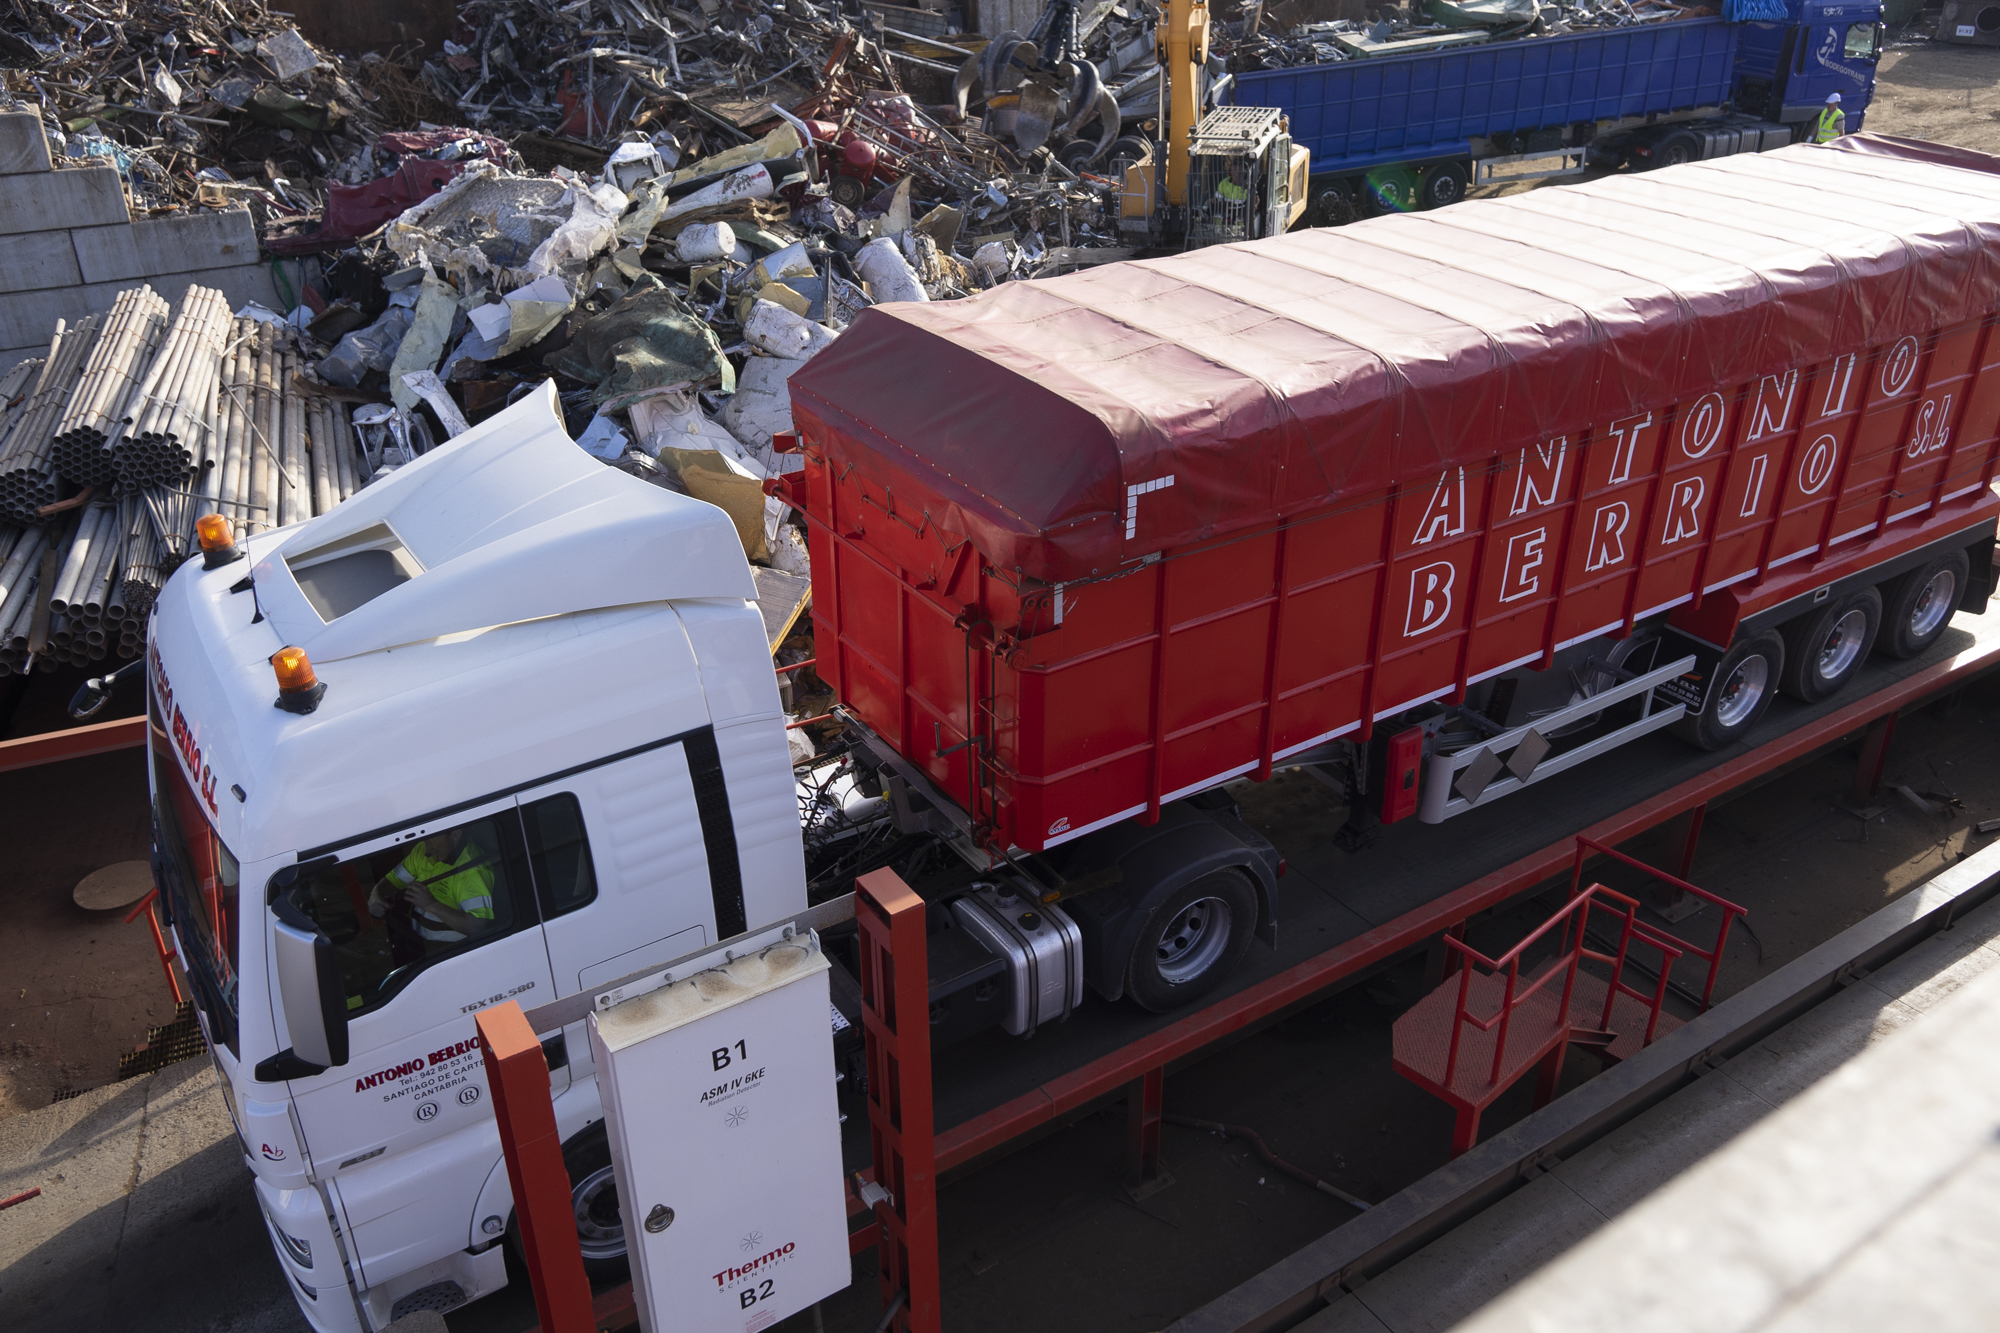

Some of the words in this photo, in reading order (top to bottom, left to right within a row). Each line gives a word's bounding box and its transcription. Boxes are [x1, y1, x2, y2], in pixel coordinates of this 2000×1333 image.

[1825, 60, 1865, 82] BODEGOTRANS
[1412, 335, 1918, 545] ANTONIO
[1403, 434, 1836, 637] BERRIO
[172, 702, 202, 783] BERRIO
[460, 999, 487, 1014] TGX
[355, 1058, 425, 1093] ANTONIO
[427, 1036, 480, 1066] BERRIO
[419, 1068, 436, 1079] 942
[437, 1062, 448, 1073] 80
[450, 1058, 461, 1068] 53
[462, 1053, 473, 1063] 16
[711, 1039, 747, 1071] B1
[383, 1078, 435, 1102] SANTIAGO
[438, 1071, 451, 1082] DE
[413, 1075, 468, 1101] CANTABRIA
[699, 1083, 728, 1103] ASM
[730, 1076, 743, 1090] IV
[745, 1066, 766, 1084] 6KE
[708, 1090, 735, 1107] Radiation
[736, 1081, 761, 1096] Detector
[712, 1241, 796, 1287] Thermo
[718, 1252, 795, 1294] SCIENTIFIC
[740, 1278, 775, 1310] B2
